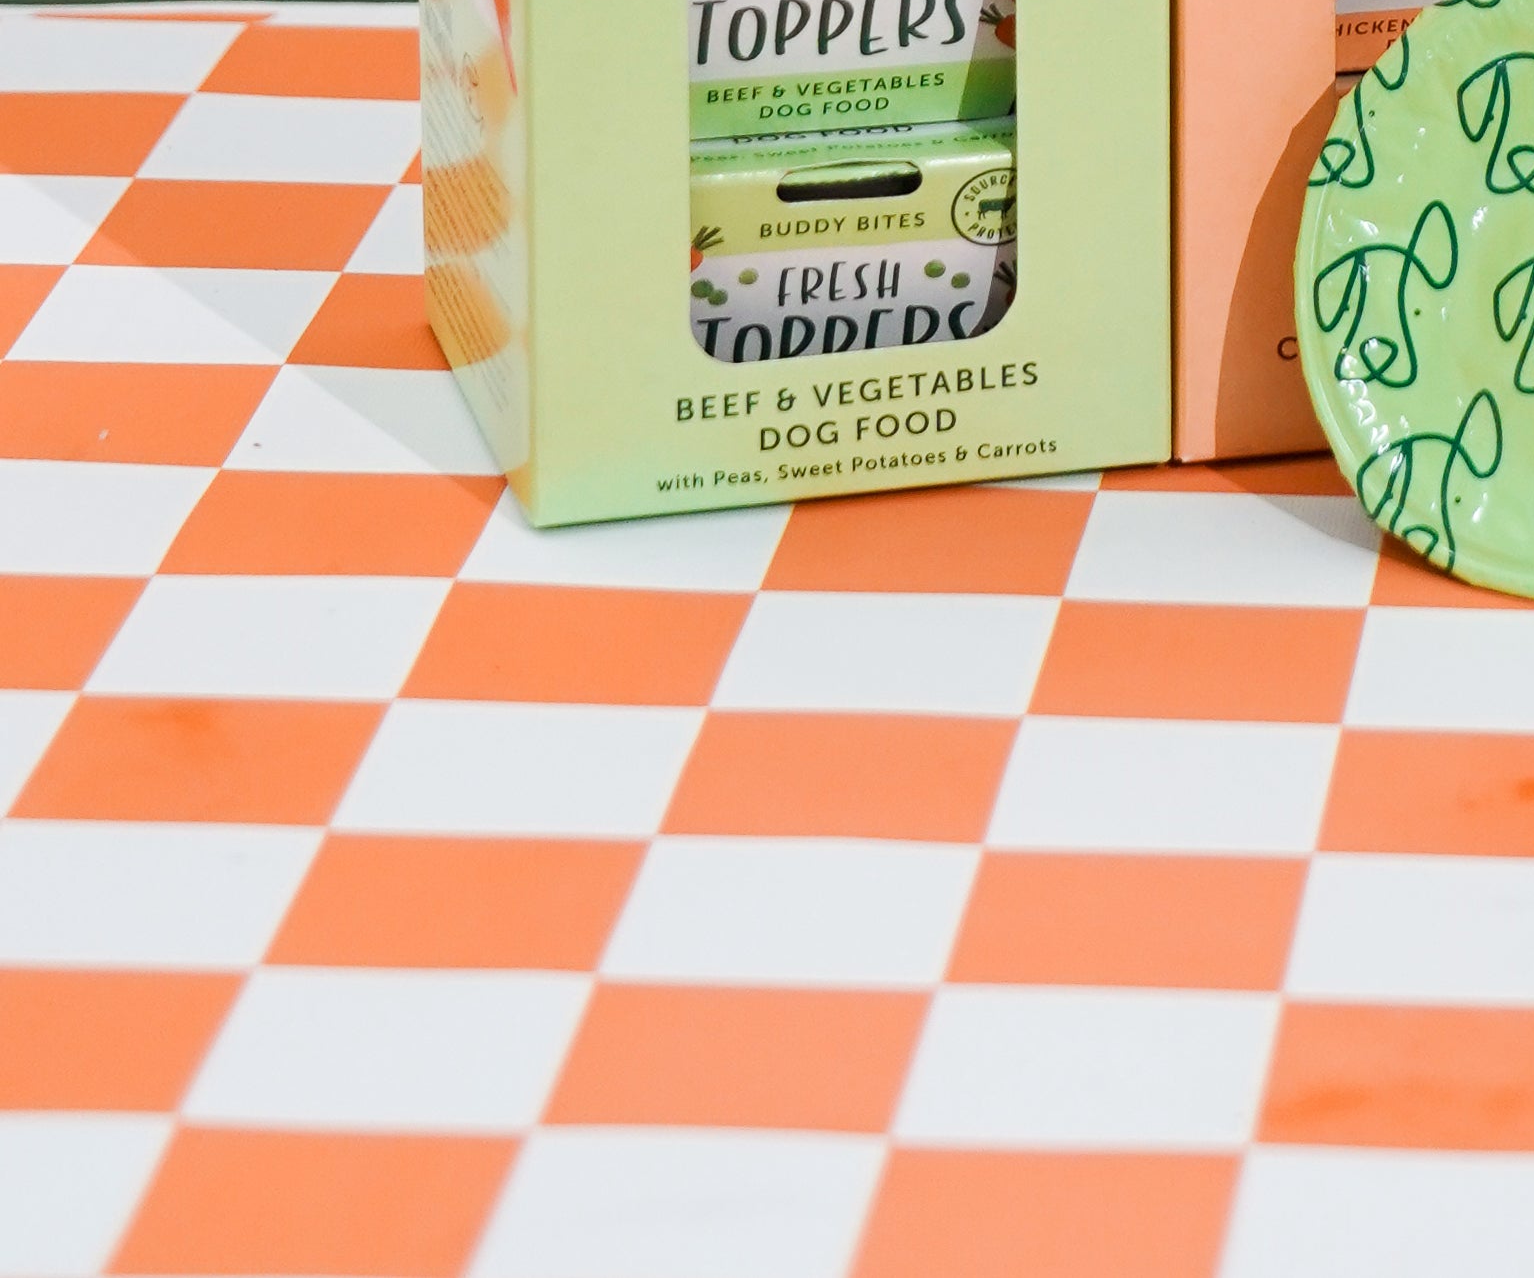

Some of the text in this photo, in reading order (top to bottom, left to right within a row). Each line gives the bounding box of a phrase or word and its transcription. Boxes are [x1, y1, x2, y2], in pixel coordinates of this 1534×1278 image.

[1335, 17, 1415, 37] HICKEN
[707, 72, 945, 104] BEEF & VEGETABLES
[759, 96, 890, 120] DOG FOOD
[759, 211, 926, 239] BUDDY BITES
[778, 259, 901, 306] FRESH
[676, 361, 1039, 421] BEEF & VEGETABLES
[759, 409, 957, 451] DOG FOOD
[657, 439, 1058, 492] with Peas, Sweet Potatoes & Carrots
